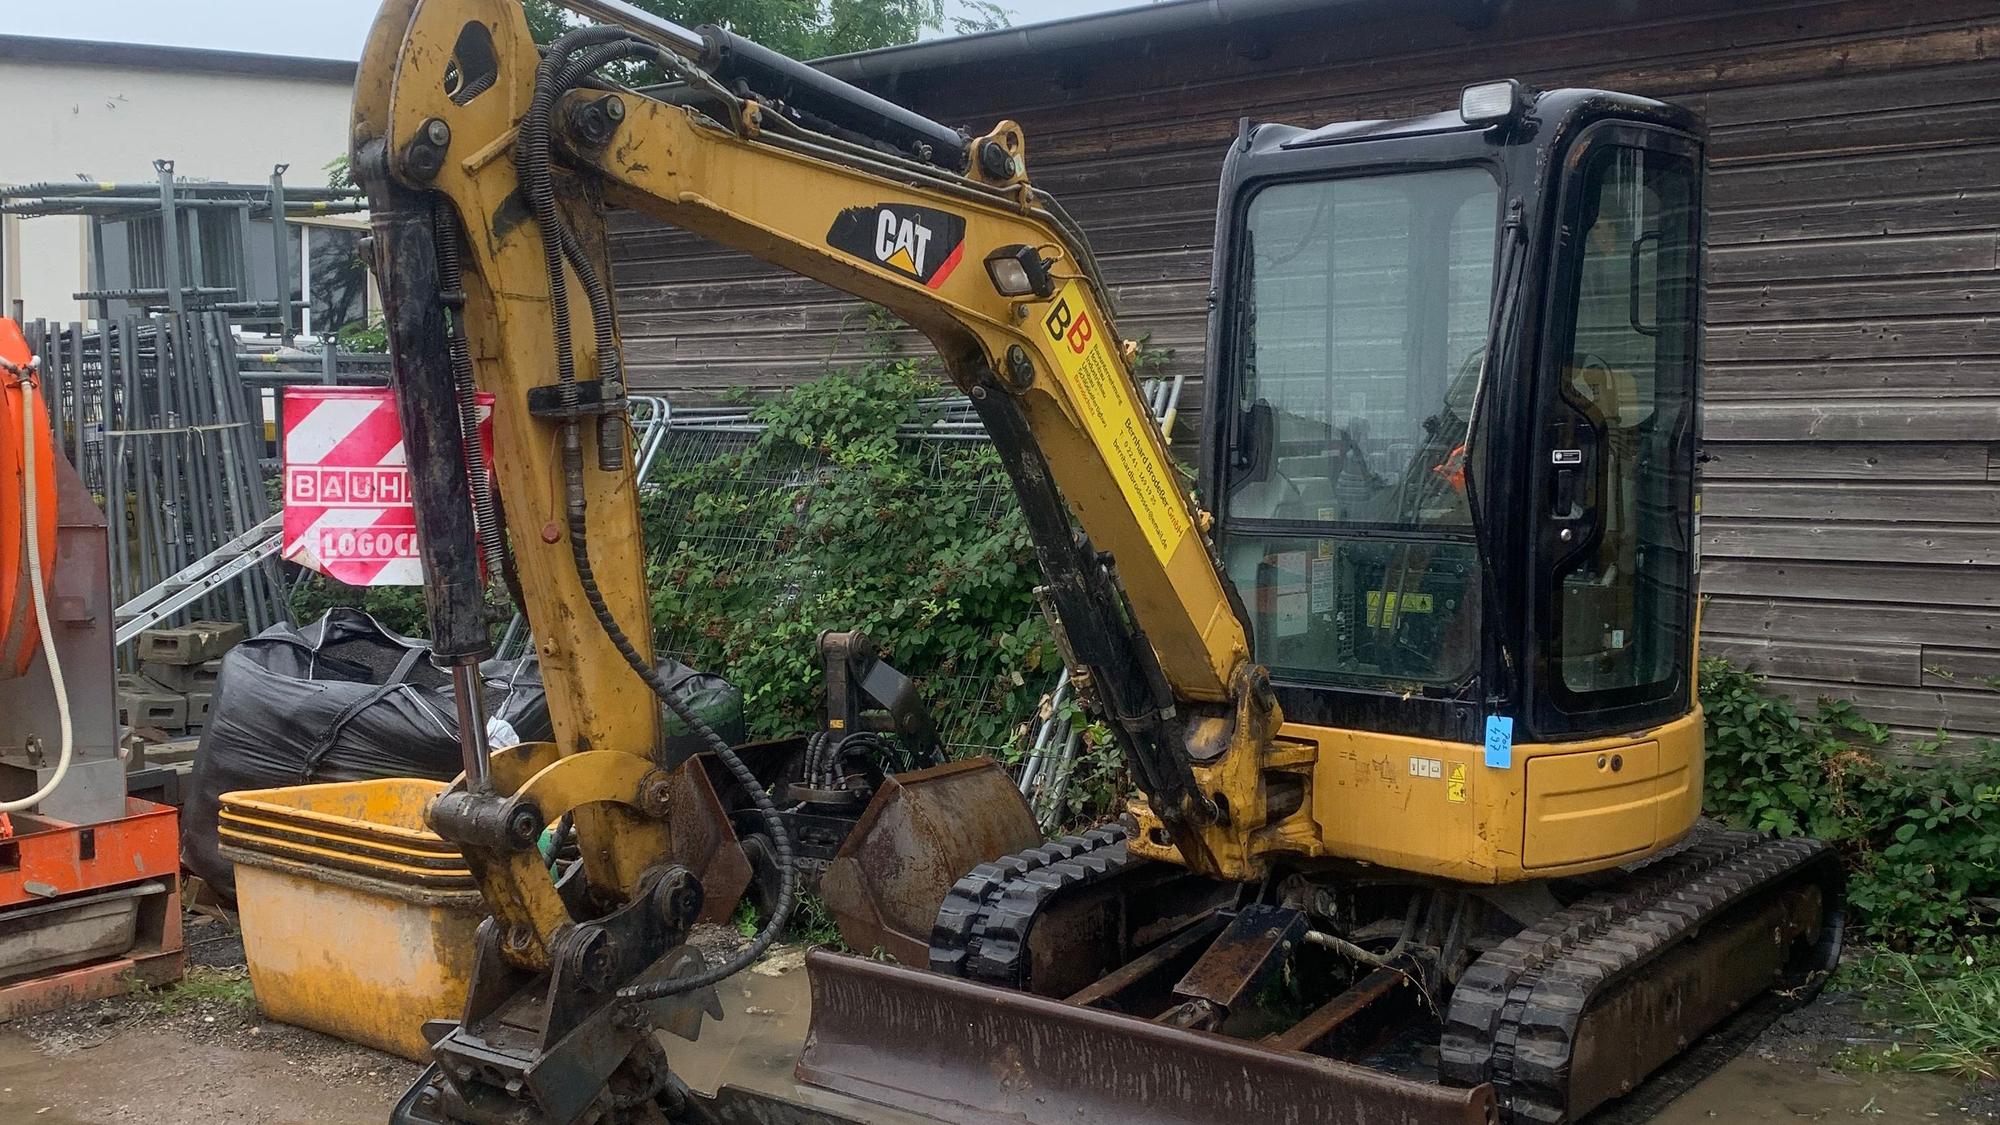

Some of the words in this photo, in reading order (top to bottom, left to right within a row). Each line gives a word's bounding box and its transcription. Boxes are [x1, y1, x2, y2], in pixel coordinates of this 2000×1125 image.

[875, 209, 932, 277] CAT
[295, 474, 412, 499] BAUH
[1124, 417, 1149, 465] Bernhard
[1145, 462, 1169, 508] Brodeßer
[1167, 506, 1184, 537] GmbH
